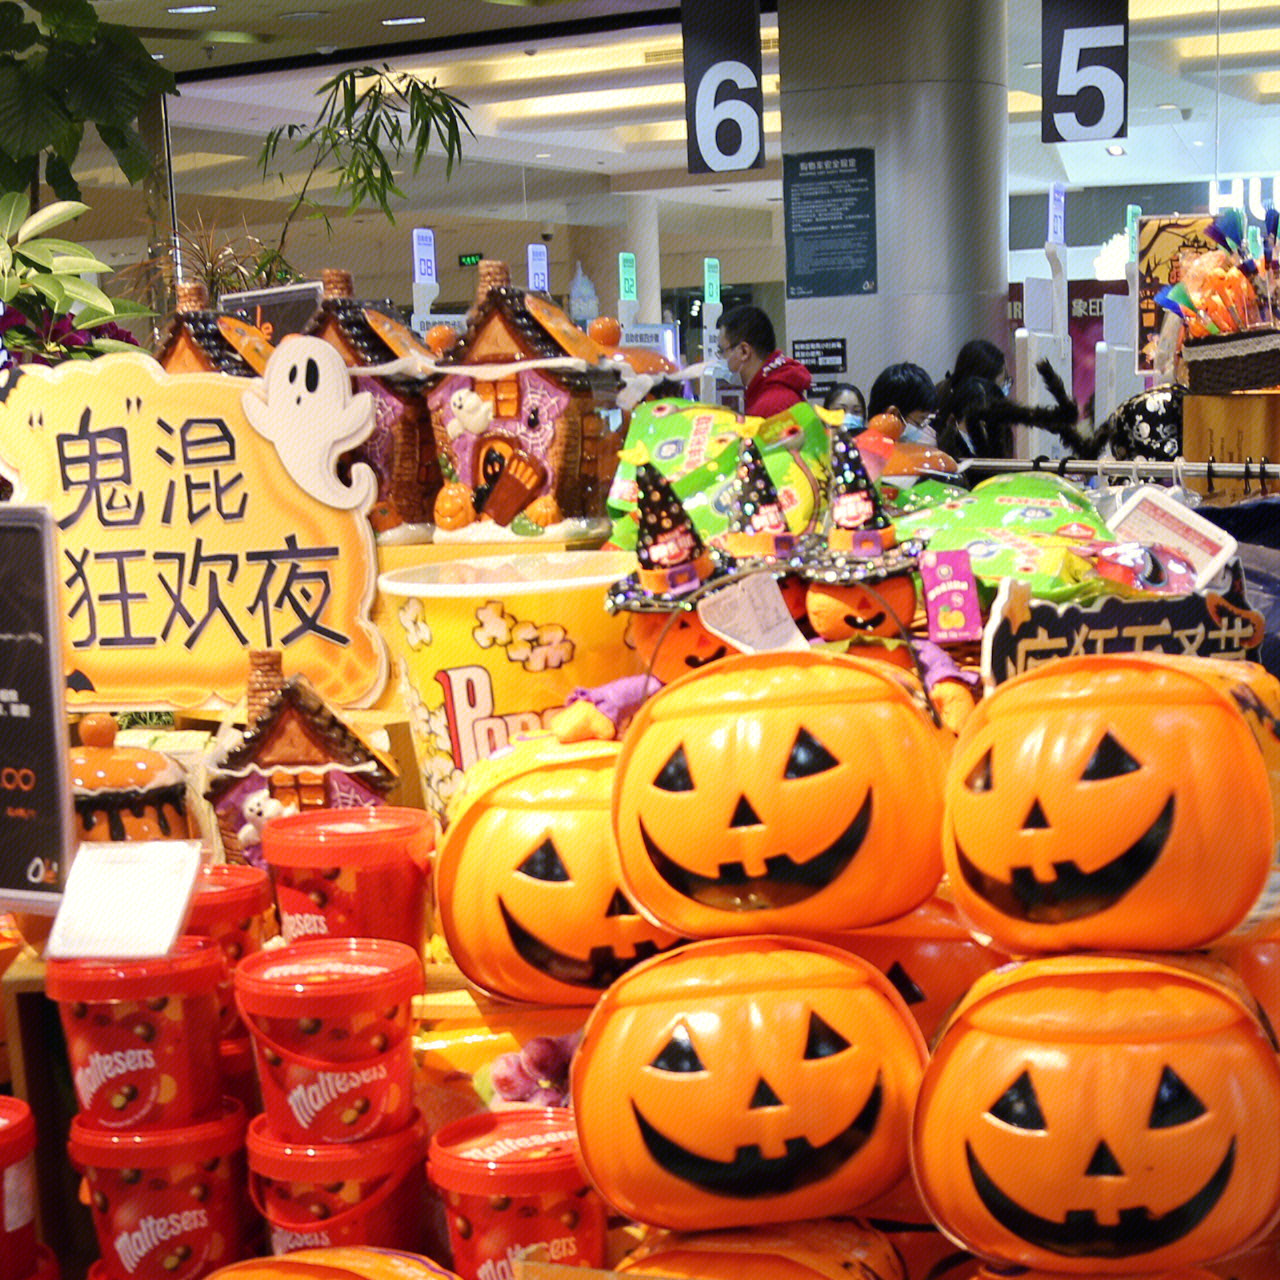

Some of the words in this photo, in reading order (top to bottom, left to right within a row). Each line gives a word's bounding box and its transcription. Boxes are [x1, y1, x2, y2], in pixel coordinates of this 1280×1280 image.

[695, 60, 760, 172] 6
[1053, 25, 1124, 141] 5
[64, 534, 351, 651] 狂欢夜
[75, 1046, 155, 1108] Maltesers
[114, 1209, 209, 1274] Maltesers
